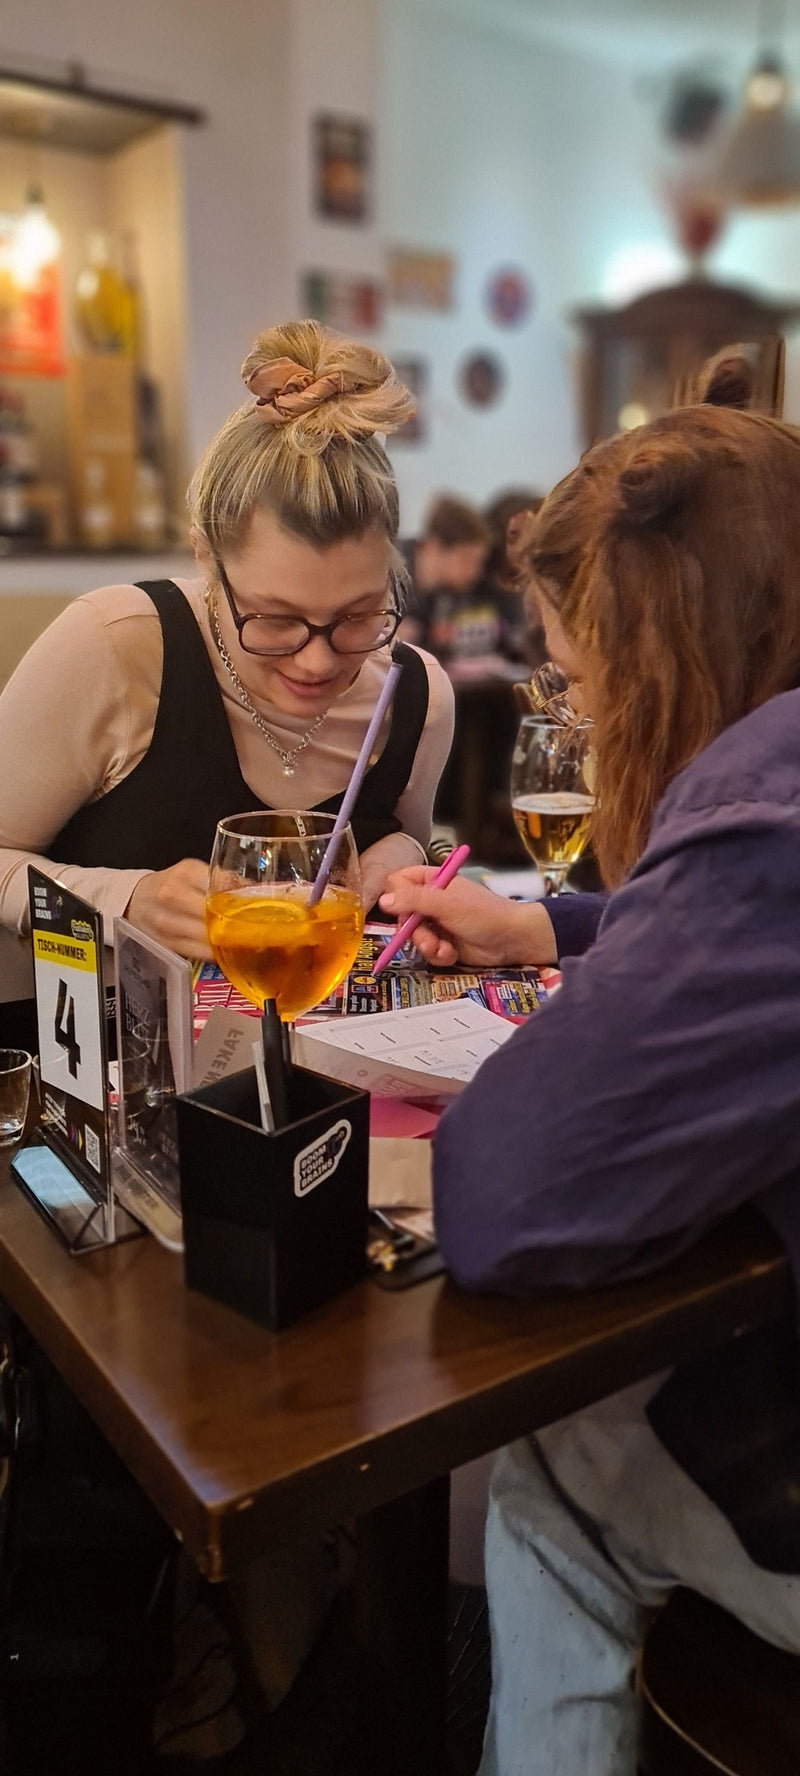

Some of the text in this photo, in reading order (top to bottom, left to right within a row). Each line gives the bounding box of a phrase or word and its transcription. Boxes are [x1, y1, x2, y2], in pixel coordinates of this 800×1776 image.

[37, 938, 87, 962] TISCH-NUMMER:
[55, 978, 81, 1080] 4
[301, 1144, 327, 1169] BOOM
[301, 1156, 324, 1178] YOUR
[301, 1158, 333, 1188] BRAINS
